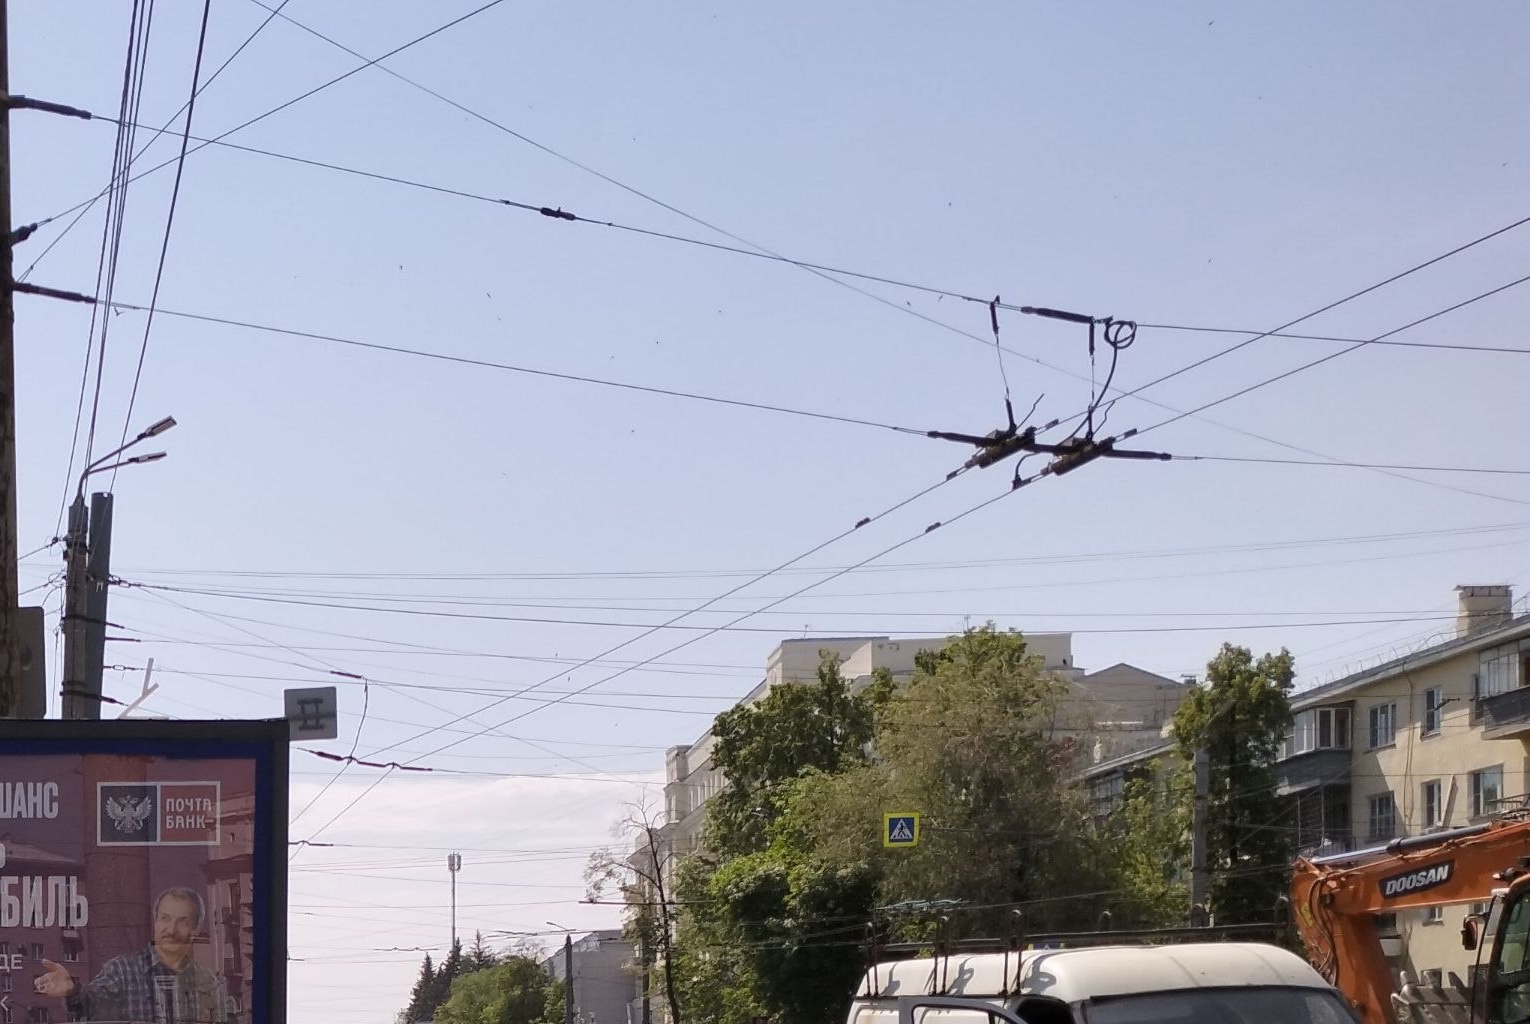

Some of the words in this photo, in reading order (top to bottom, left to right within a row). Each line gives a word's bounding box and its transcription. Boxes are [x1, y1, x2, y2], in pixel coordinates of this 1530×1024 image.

[166, 796, 212, 813] ПОЧТА
[166, 814, 207, 830] БАНК
[1385, 864, 1450, 896] DOOSAN
